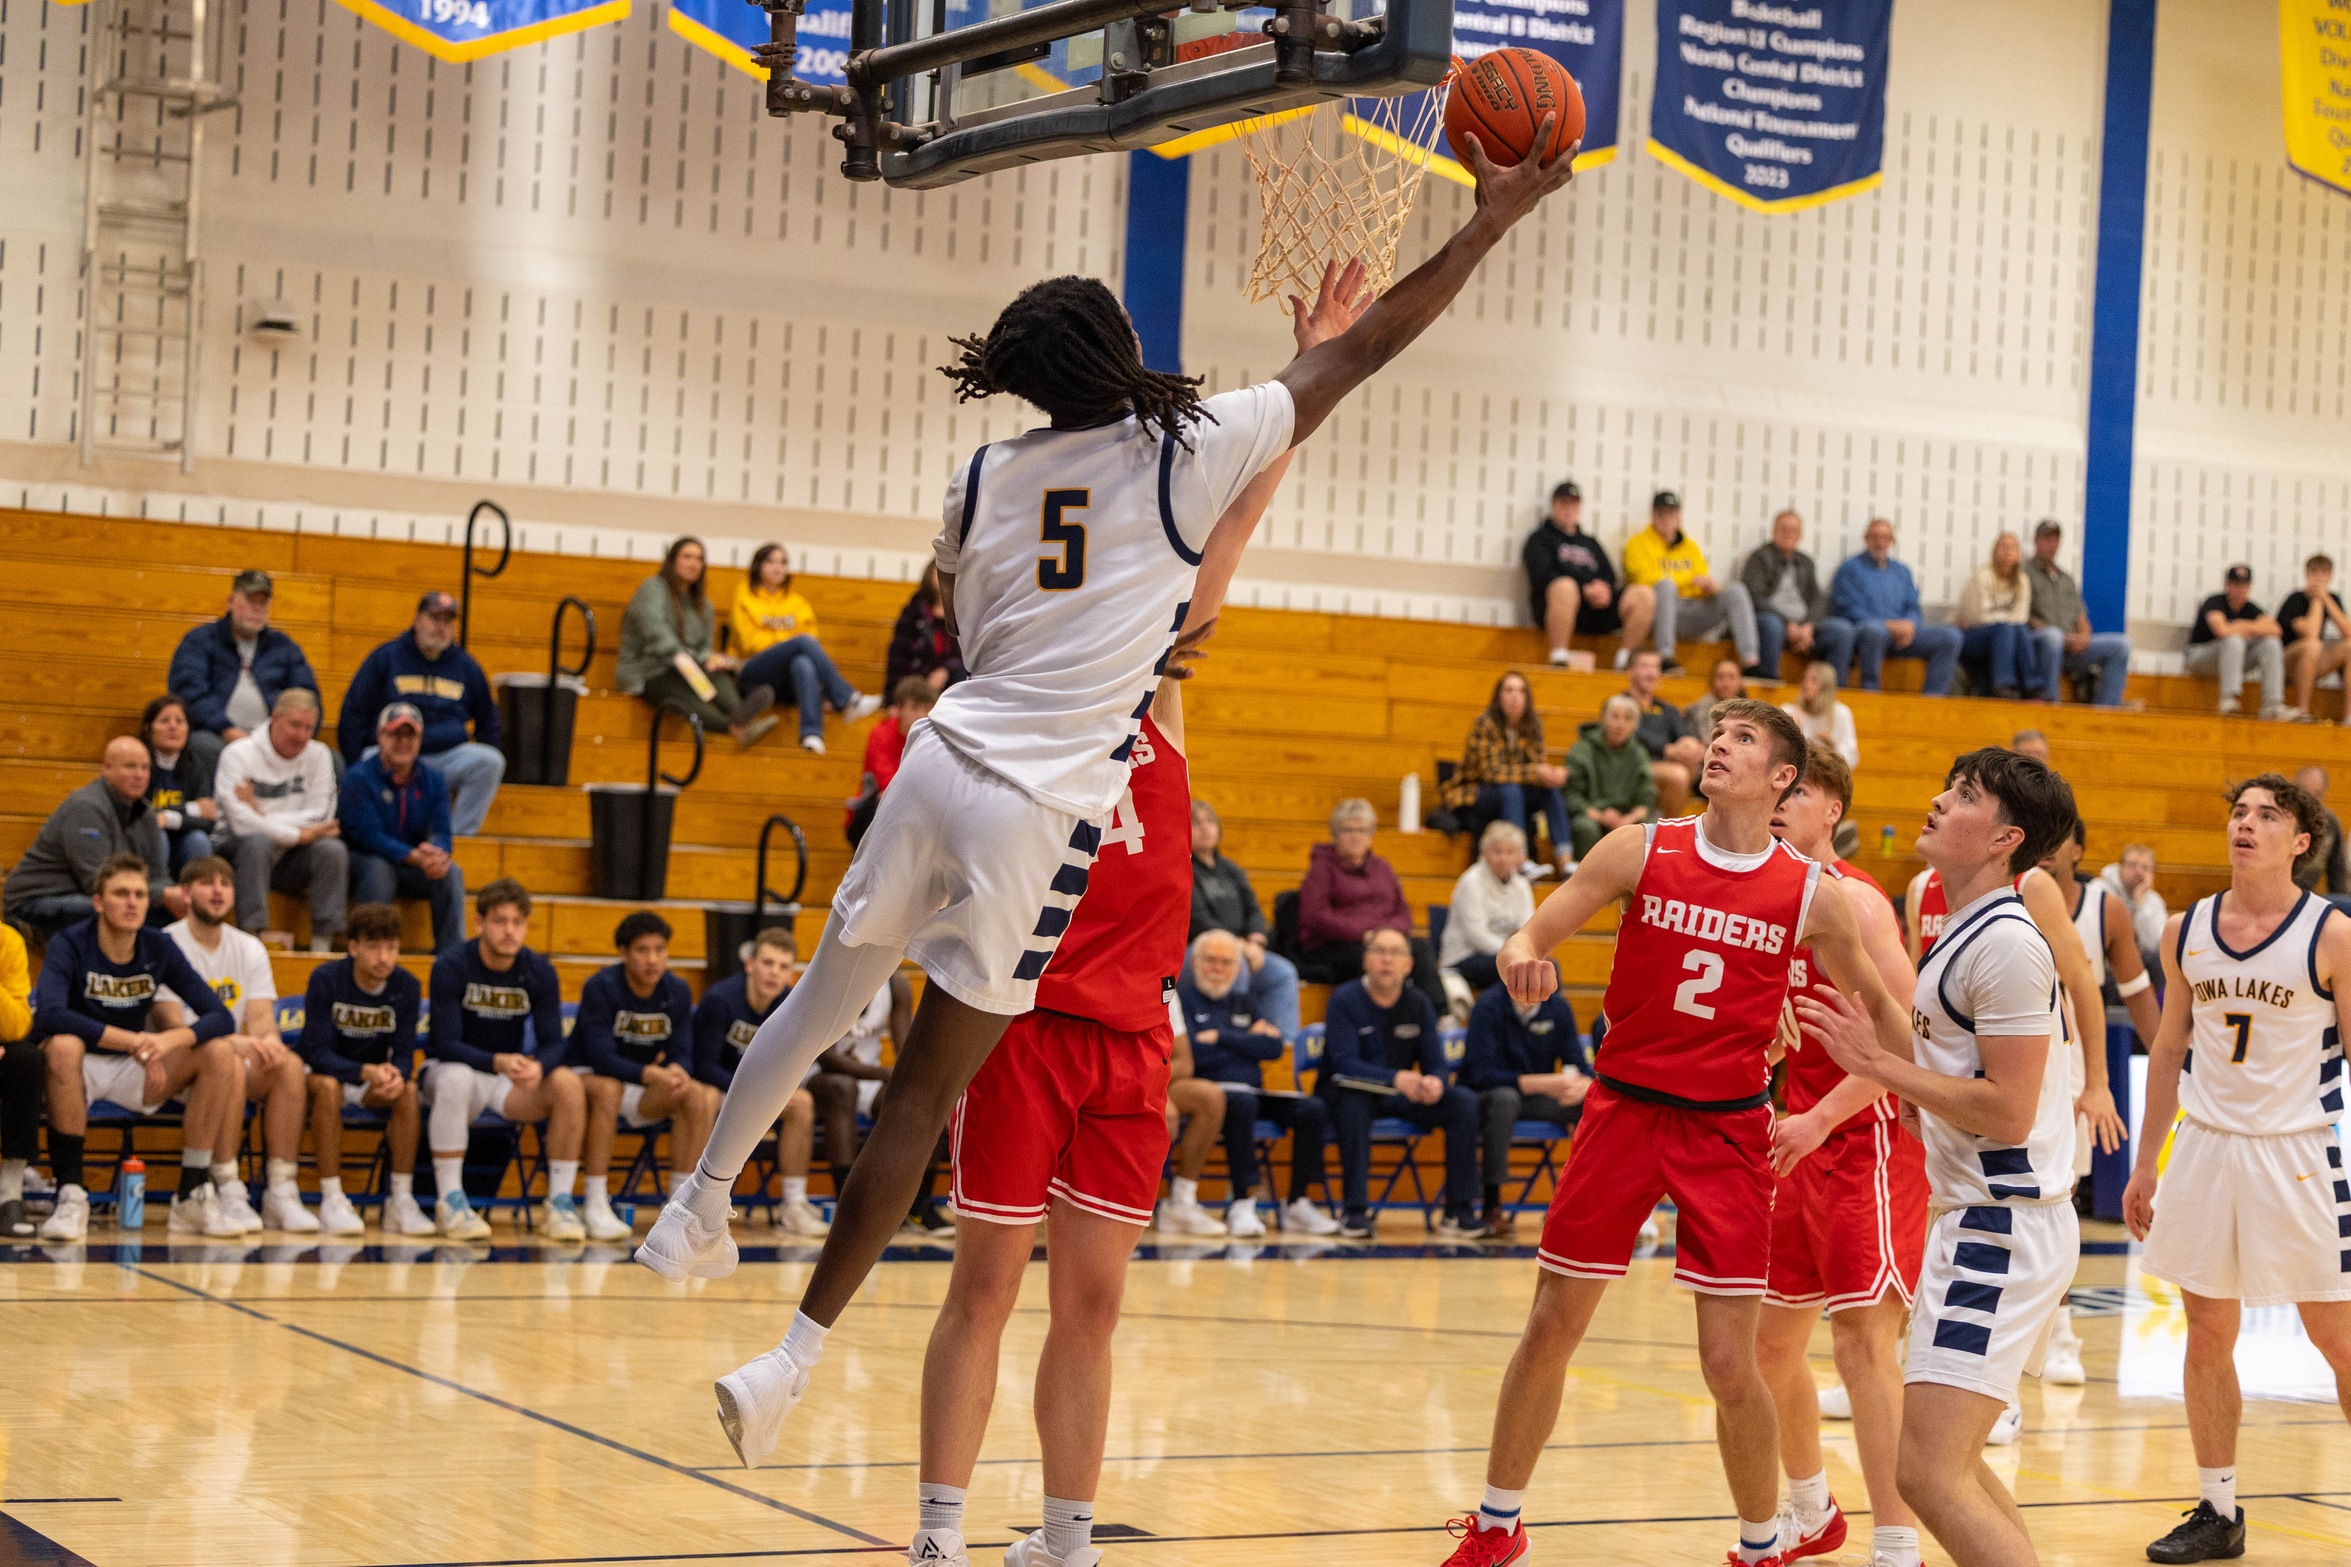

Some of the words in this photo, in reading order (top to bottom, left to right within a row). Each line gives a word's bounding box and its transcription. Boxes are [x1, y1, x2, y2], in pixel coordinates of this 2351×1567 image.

[1453, 11, 1510, 35] entral
[1527, 17, 1596, 46] District
[1731, 0, 1823, 29] Basketball
[1678, 14, 1747, 45] Region
[1769, 31, 1865, 62] Champions
[796, 45, 849, 78] 200
[1680, 42, 1735, 71] North
[1736, 52, 1798, 82] Central
[1799, 62, 1865, 88] District
[1722, 77, 1823, 111] Champions
[1683, 94, 1753, 130] National
[1725, 132, 1814, 165] Qualifiers
[1744, 164, 1790, 189] 2023
[1035, 487, 1092, 592] 5
[1641, 894, 1787, 955] RAIDERS
[86, 971, 156, 1000] LAKER
[1673, 949, 1725, 1020] 2
[2235, 977, 2295, 1009] LAKES
[2224, 1011, 2253, 1064] 7
